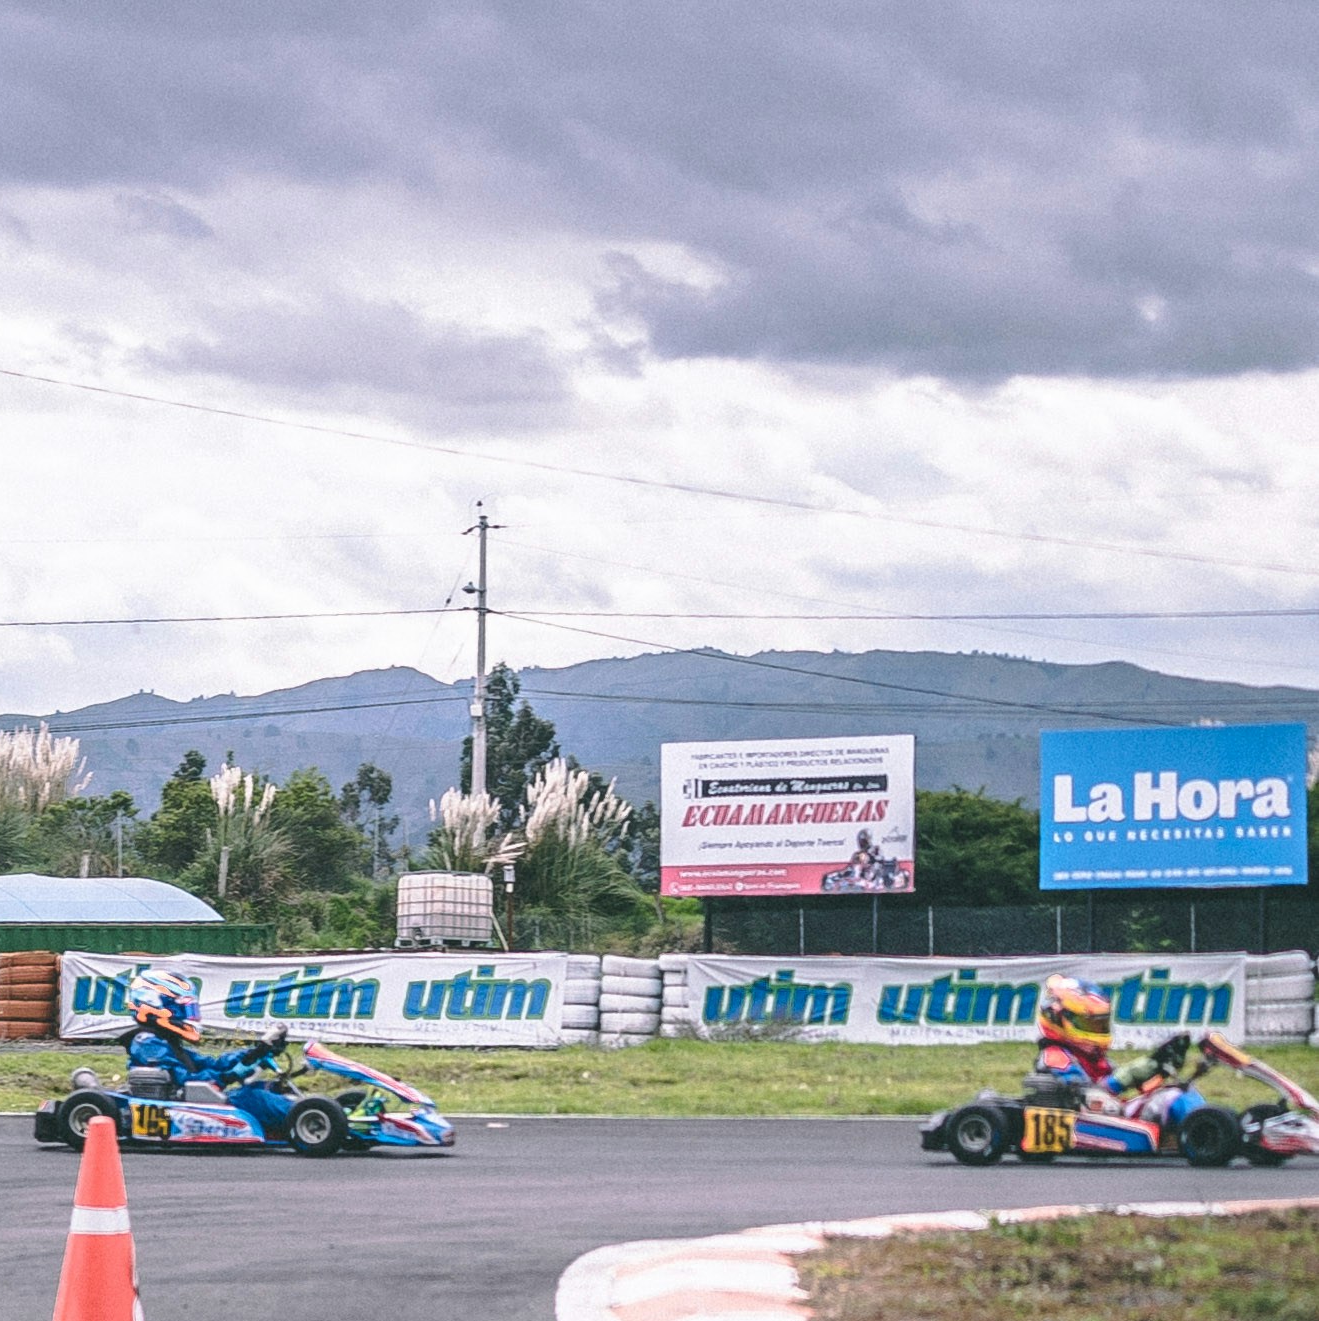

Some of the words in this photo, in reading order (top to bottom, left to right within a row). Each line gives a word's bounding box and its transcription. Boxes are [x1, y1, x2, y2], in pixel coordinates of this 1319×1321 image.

[774, 781, 789, 793] de
[1053, 774, 1126, 823] La
[1133, 771, 1291, 821] Hora
[682, 800, 890, 828] ECUAMANGUERAS
[1053, 831, 1074, 843] LO
[1084, 830, 1117, 842] QUE
[1126, 827, 1225, 841] NECESITAS
[1235, 825, 1292, 839] SABER
[224, 965, 380, 1019] utim
[403, 964, 552, 1020] utim
[702, 968, 854, 1026] utim
[876, 968, 1042, 1027] utim
[1033, 1113, 1071, 1147] 185
